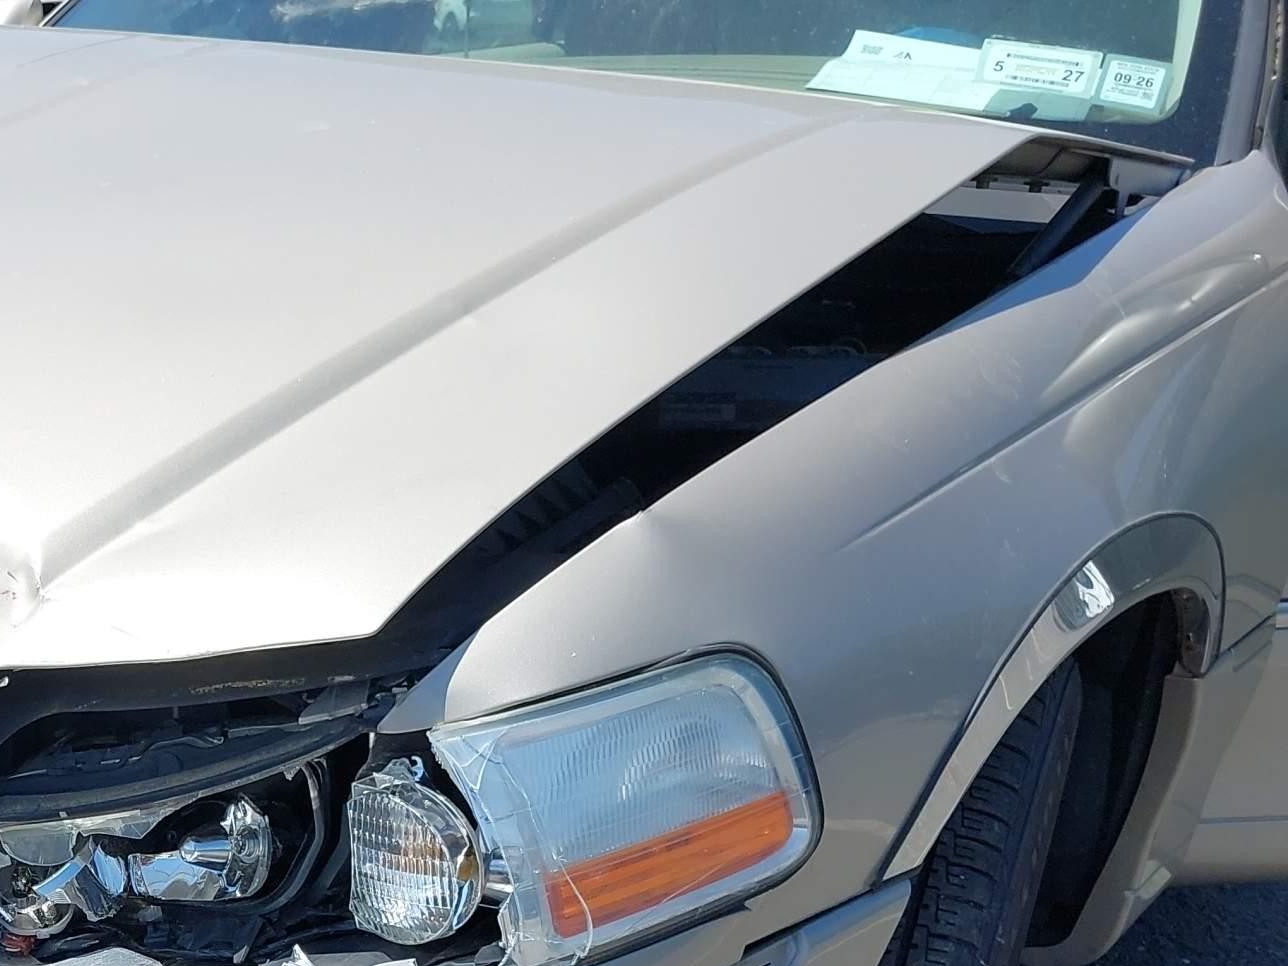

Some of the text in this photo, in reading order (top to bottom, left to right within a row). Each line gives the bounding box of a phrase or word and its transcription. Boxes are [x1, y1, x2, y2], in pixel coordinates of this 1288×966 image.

[993, 60, 1005, 72] 5
[1061, 69, 1085, 83] 27
[1113, 71, 1155, 88] 09 26
